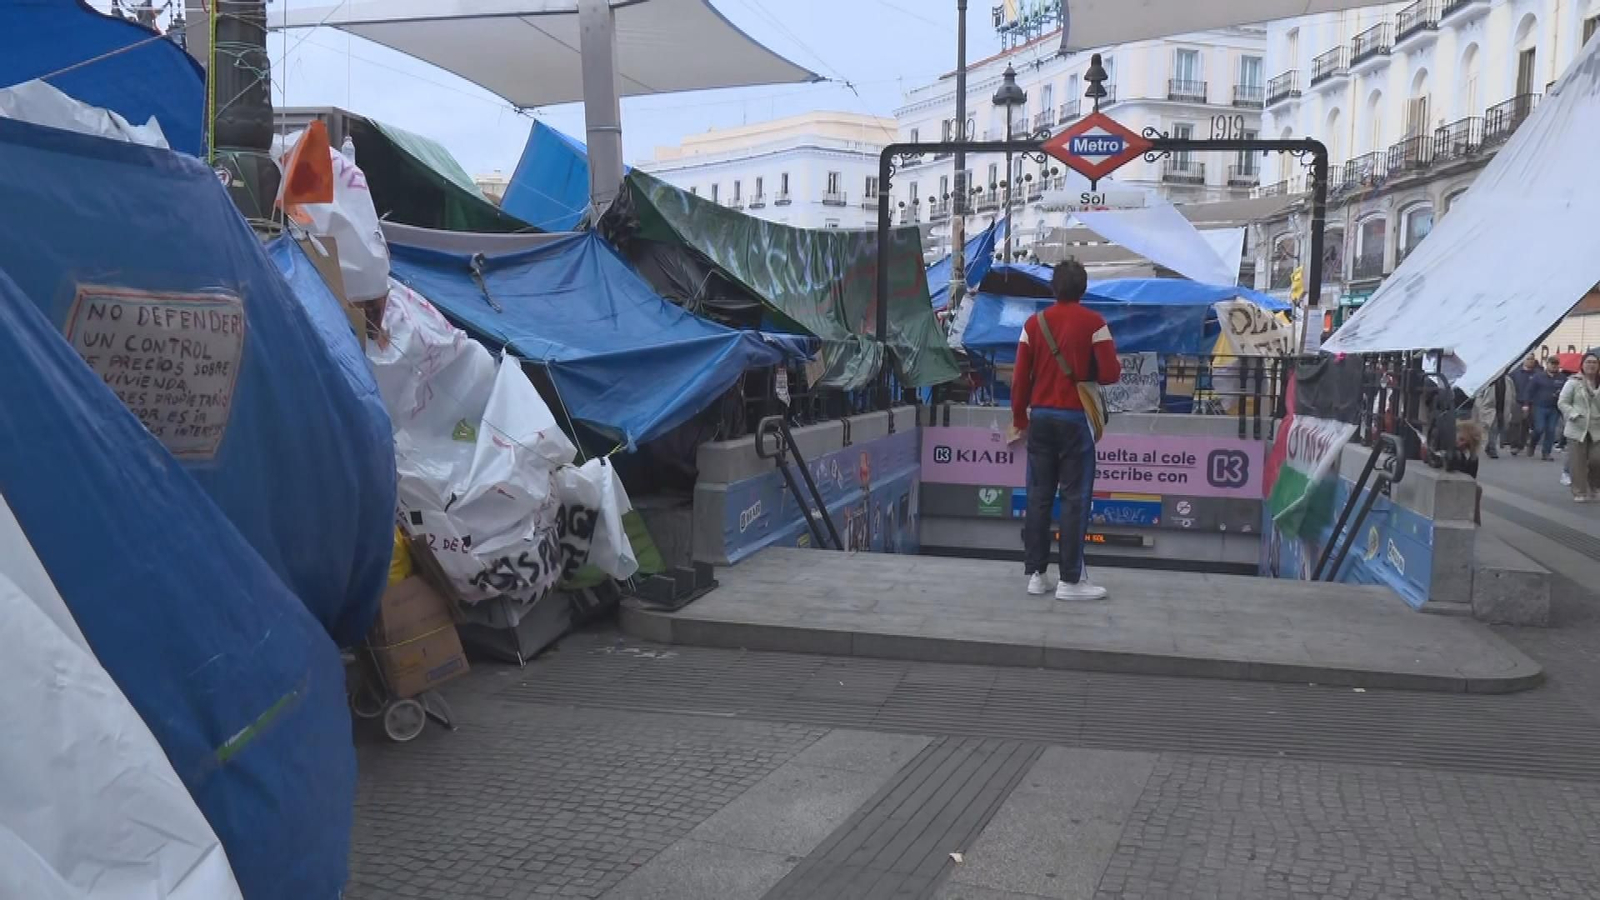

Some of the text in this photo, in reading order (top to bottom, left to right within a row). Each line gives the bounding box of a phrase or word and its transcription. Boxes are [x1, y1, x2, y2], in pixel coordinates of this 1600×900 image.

[1210, 115, 1244, 140] 1919
[1074, 138, 1119, 153] Metro
[1080, 192, 1106, 205] Sol
[87, 303, 123, 321] NO
[83, 332, 213, 361] UN CONTROL
[194, 361, 231, 377] SOBRE
[957, 449, 1014, 464] KIABI
[1096, 448, 1196, 465] uelta al cole
[1158, 472, 1188, 483] con
